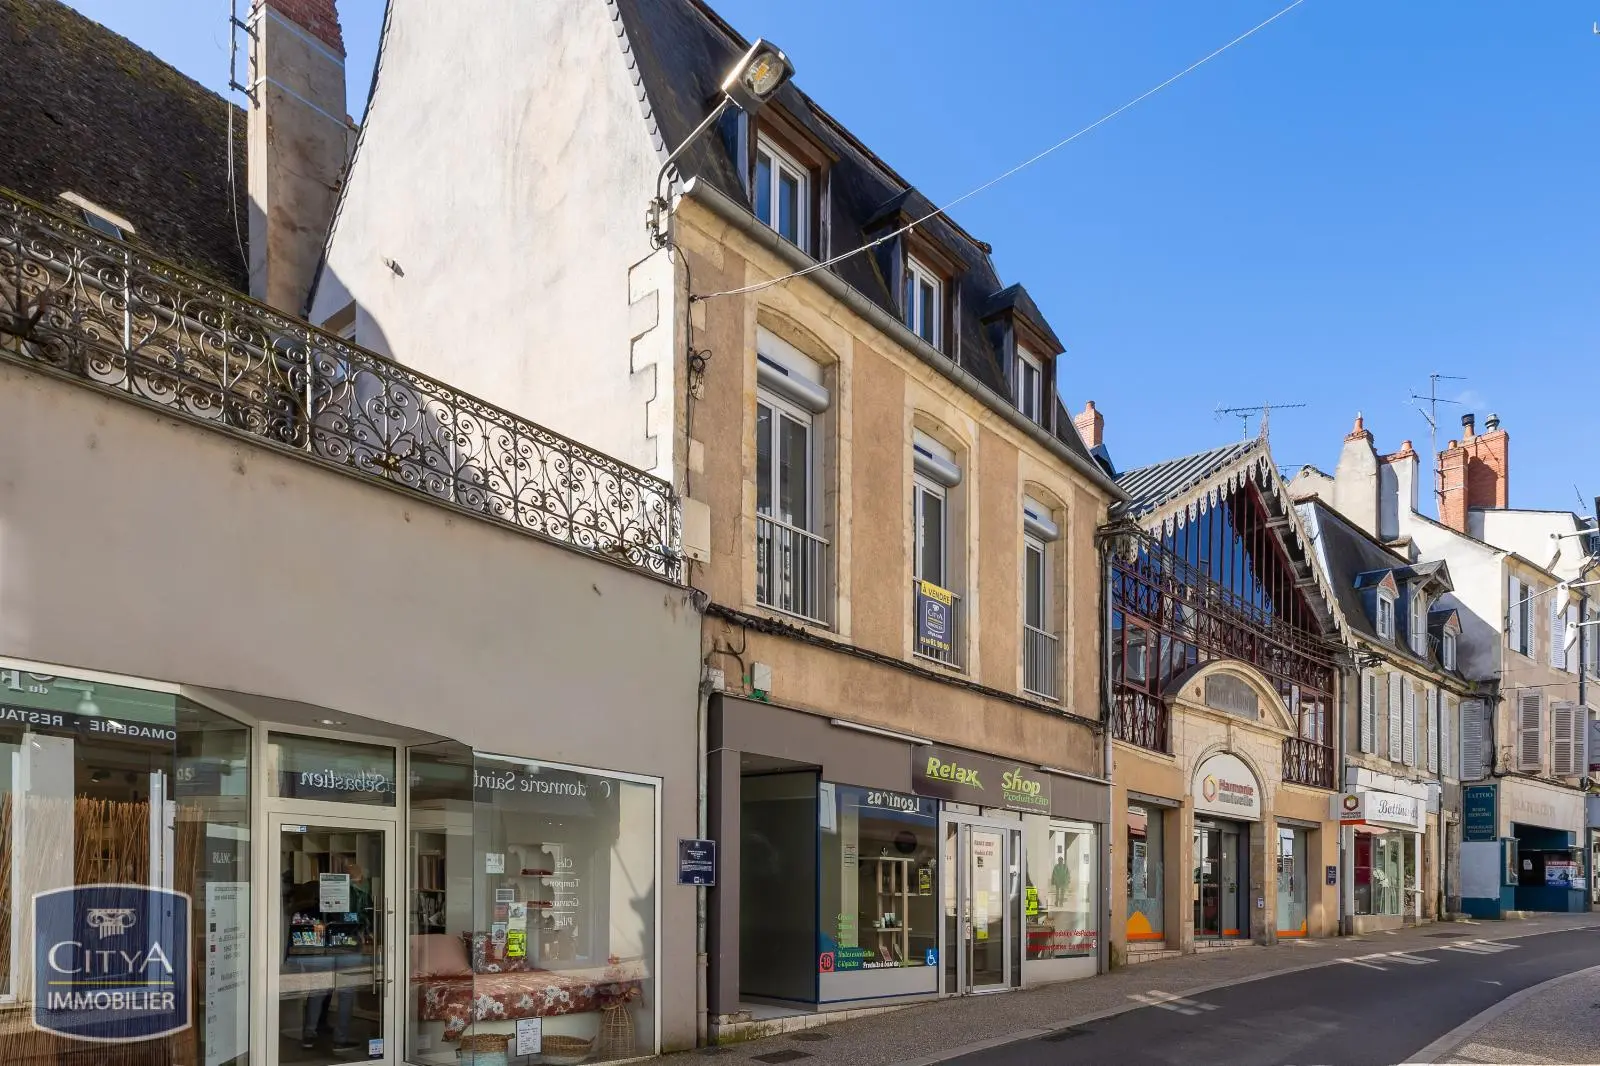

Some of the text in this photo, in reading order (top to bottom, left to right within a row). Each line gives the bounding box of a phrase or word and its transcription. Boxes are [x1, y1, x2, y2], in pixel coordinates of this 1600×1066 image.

[928, 588, 950, 604] VENDRE
[926, 757, 1041, 796] Relax Shop
[1218, 779, 1254, 797] Harmonie
[1003, 792, 1034, 804] Produits
